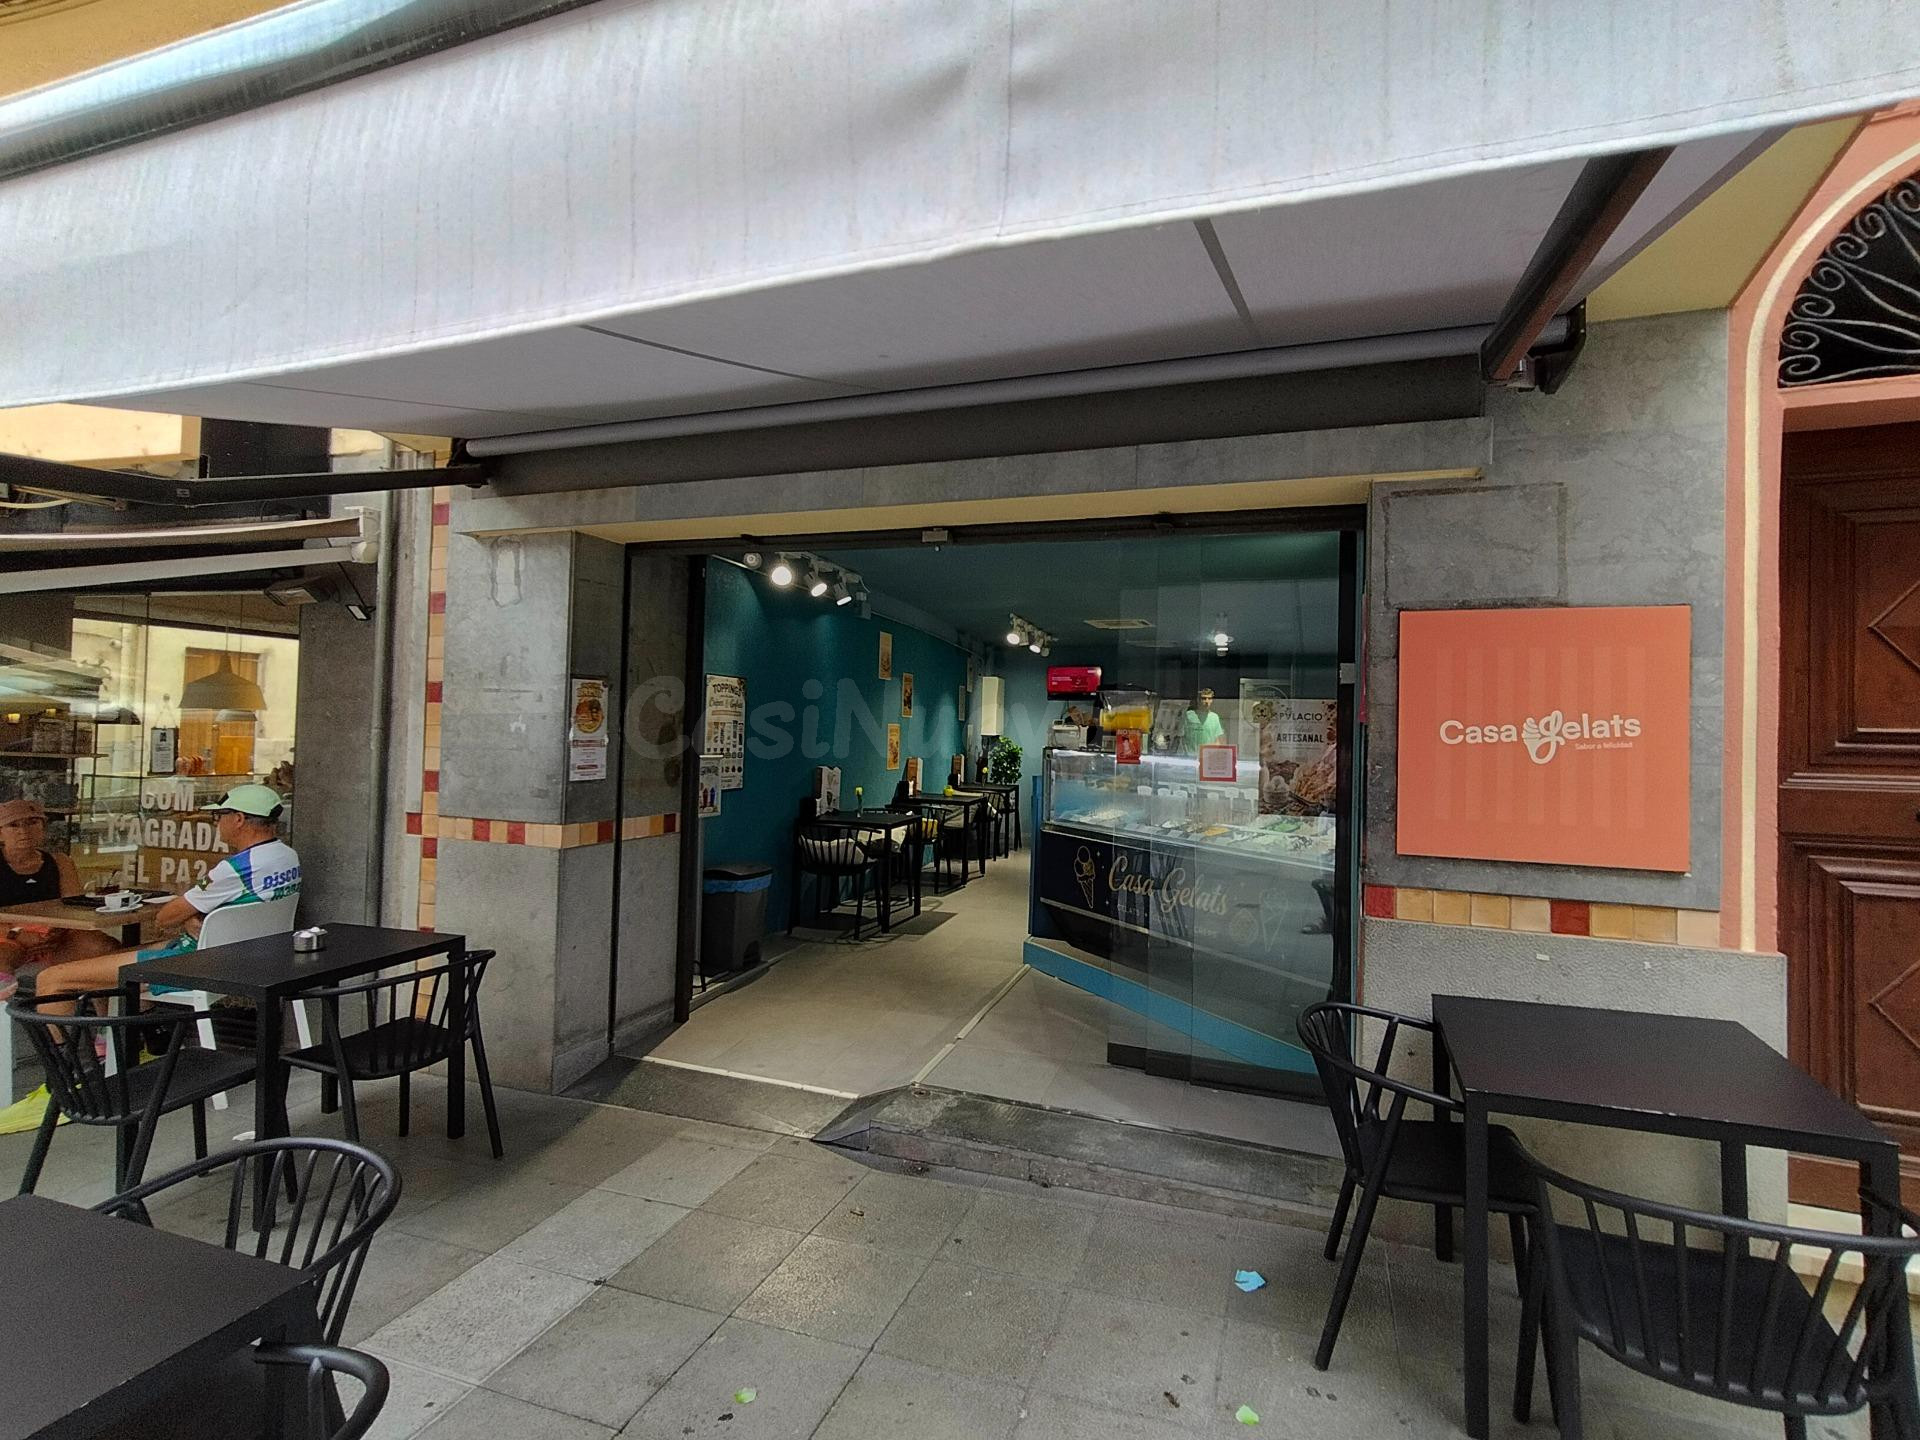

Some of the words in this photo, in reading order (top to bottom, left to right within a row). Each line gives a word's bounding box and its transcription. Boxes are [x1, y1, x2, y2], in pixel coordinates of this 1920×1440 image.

[1276, 733, 1324, 743] ARTESANAL
[1439, 719, 1518, 745] Casa
[141, 781, 195, 812] COM
[123, 854, 150, 883] EL
[1108, 855, 1154, 897] Casa
[1161, 867, 1229, 914] Gelats
